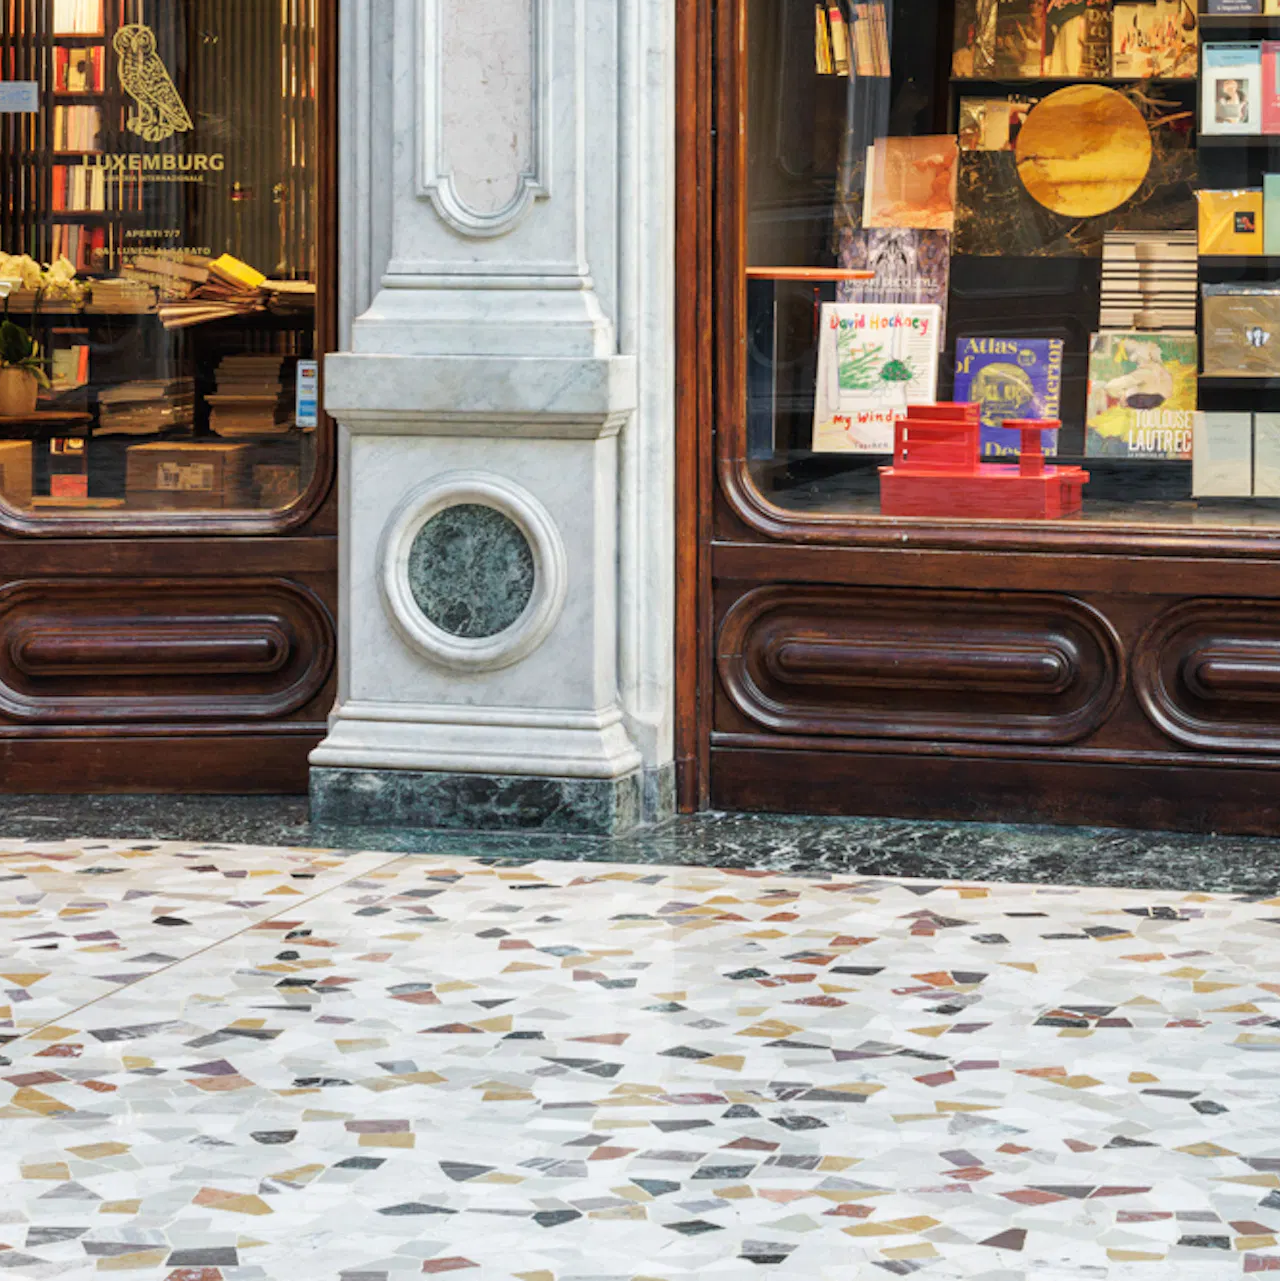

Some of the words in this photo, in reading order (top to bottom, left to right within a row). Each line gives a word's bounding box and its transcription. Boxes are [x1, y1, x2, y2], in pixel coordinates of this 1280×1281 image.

[82, 153, 225, 171] LUXEMBURG
[829, 312, 866, 330] David
[869, 310, 929, 336] Hockney
[964, 338, 1018, 355] Atlas
[1135, 409, 1193, 429] TOULOUSE
[1128, 429, 1193, 453] LAUTREC
